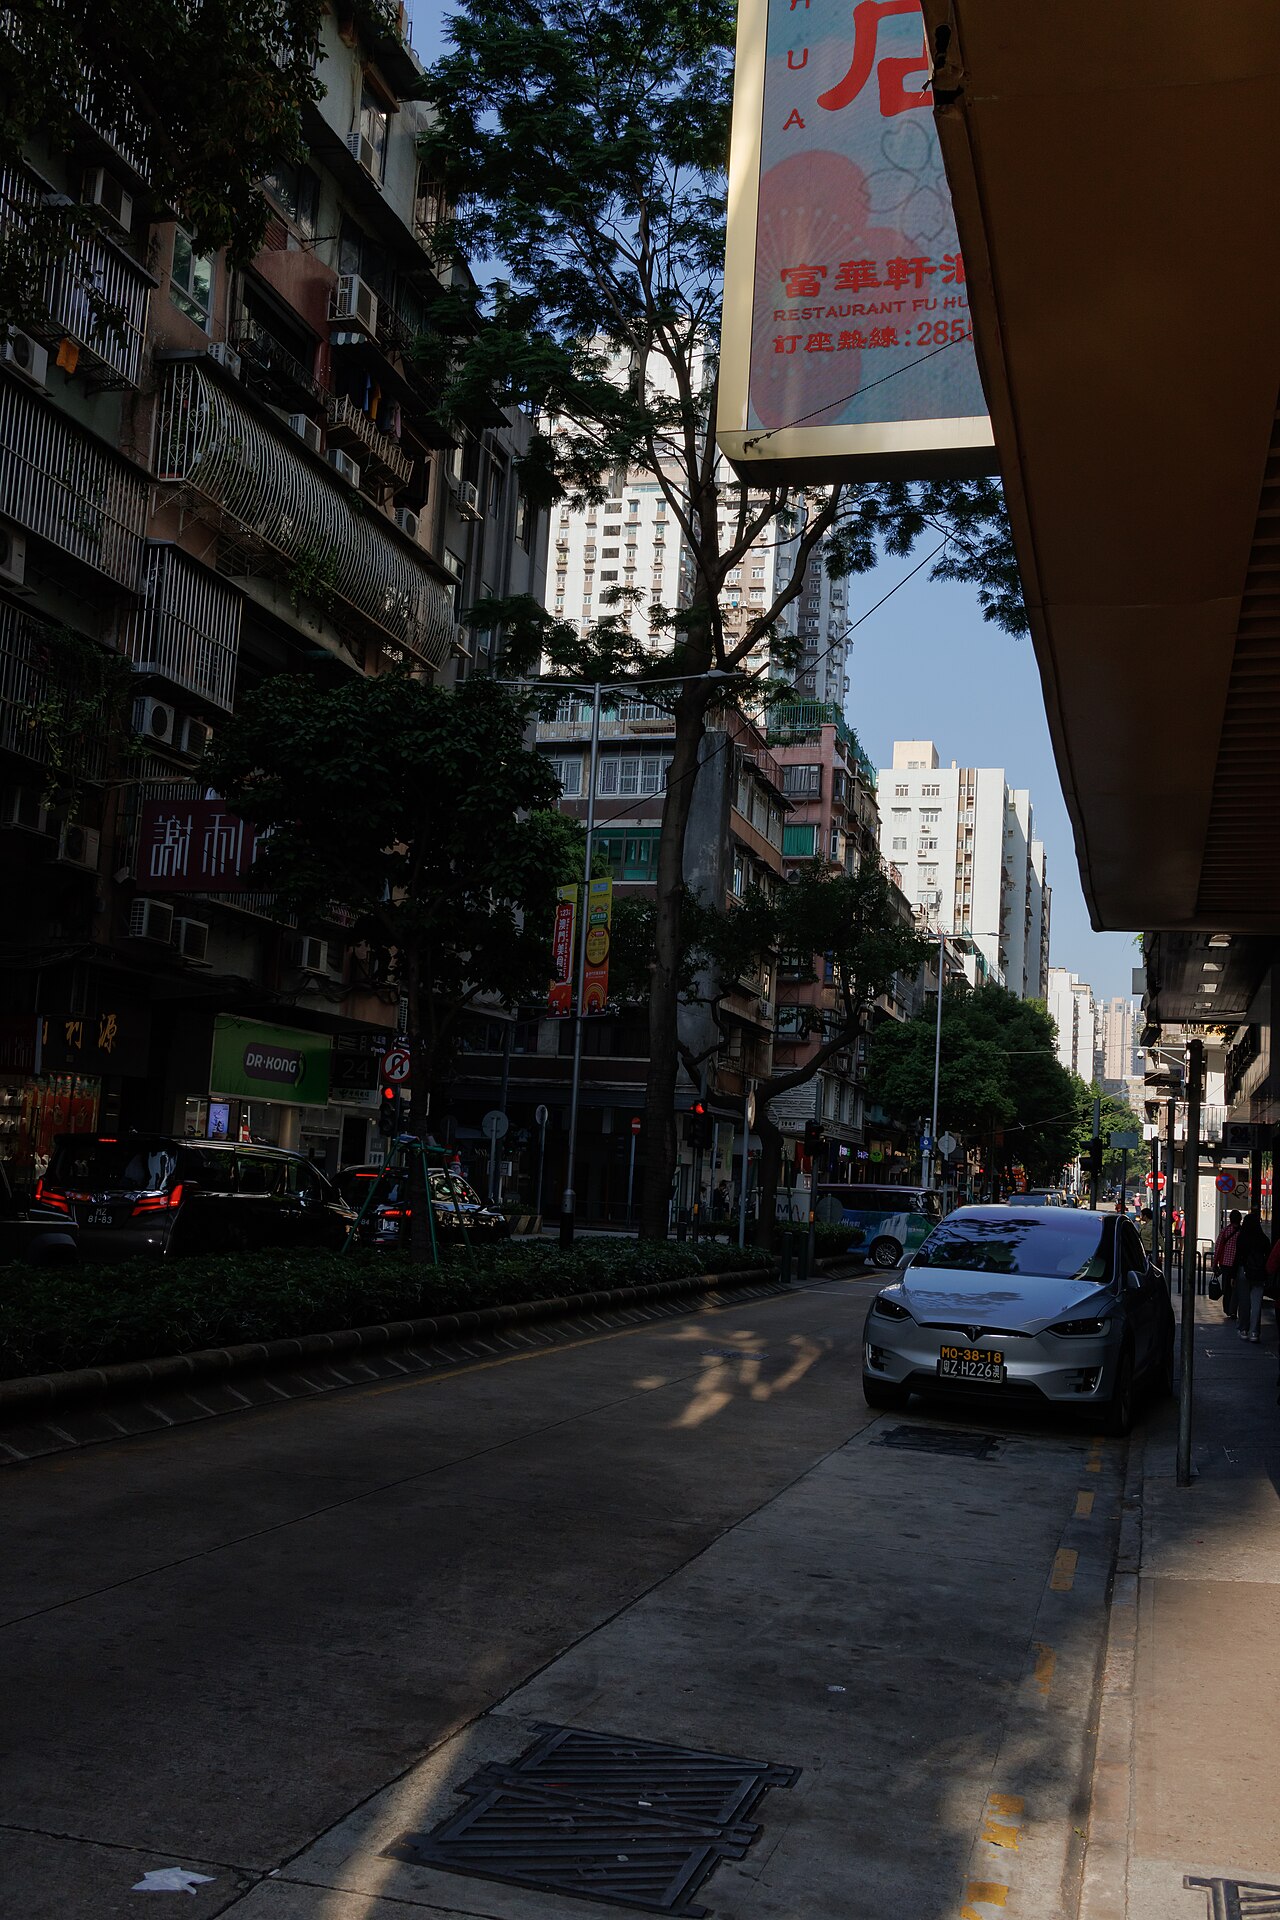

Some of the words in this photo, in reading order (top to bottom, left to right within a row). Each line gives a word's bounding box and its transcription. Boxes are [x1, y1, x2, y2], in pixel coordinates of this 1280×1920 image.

[773, 301, 906, 322] RESTAURANT
[911, 298, 937, 312] FU
[341, 1058, 371, 1081] 24
[87, 1215, 113, 1224] 81-83
